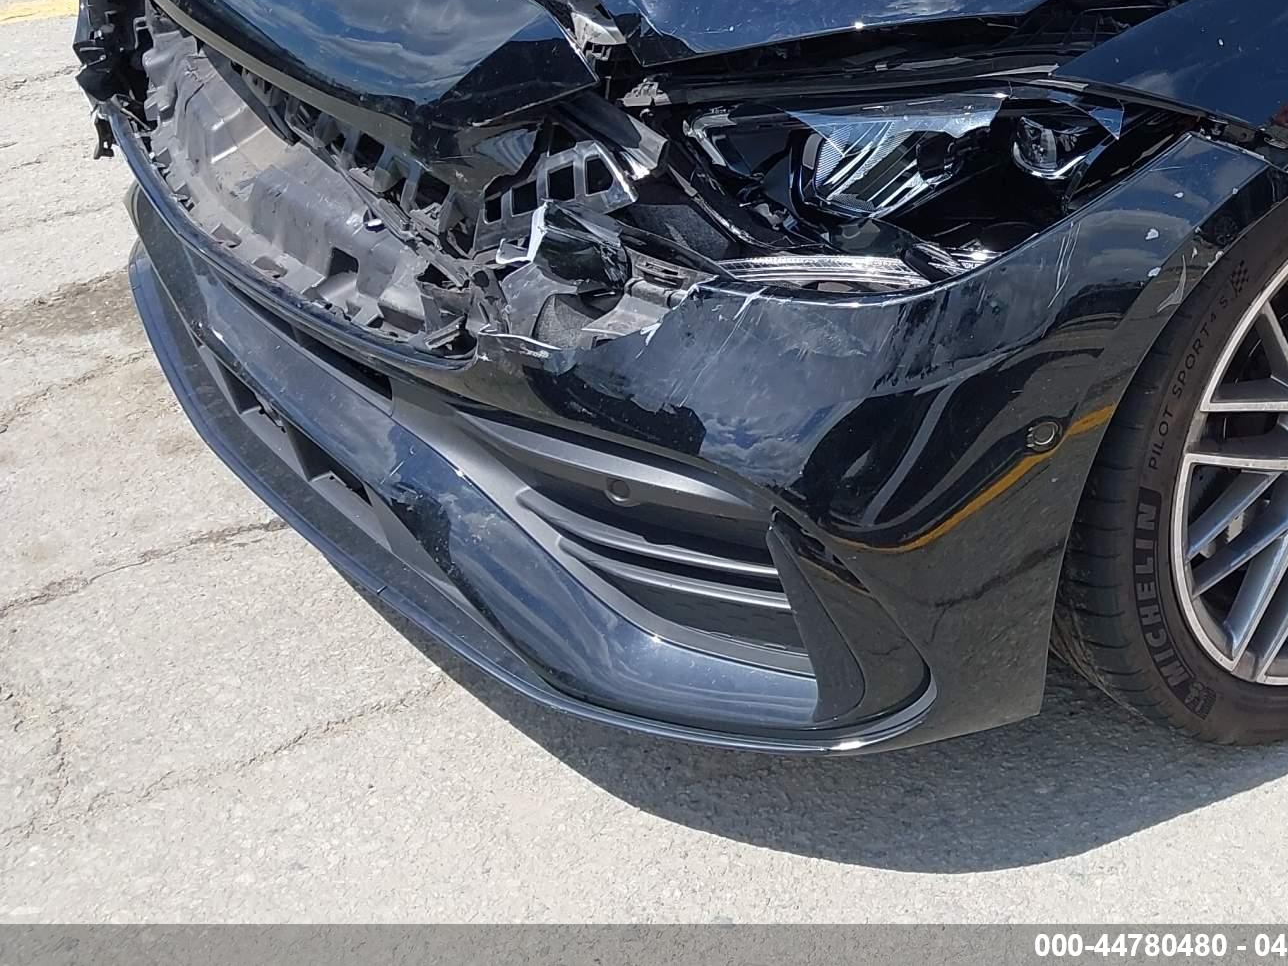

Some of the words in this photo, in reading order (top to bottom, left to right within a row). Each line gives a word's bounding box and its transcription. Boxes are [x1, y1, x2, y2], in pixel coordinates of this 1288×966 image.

[1148, 408, 1175, 471] PILOT
[1172, 322, 1210, 400] SPORT
[1135, 501, 1192, 687] MICHELIN
